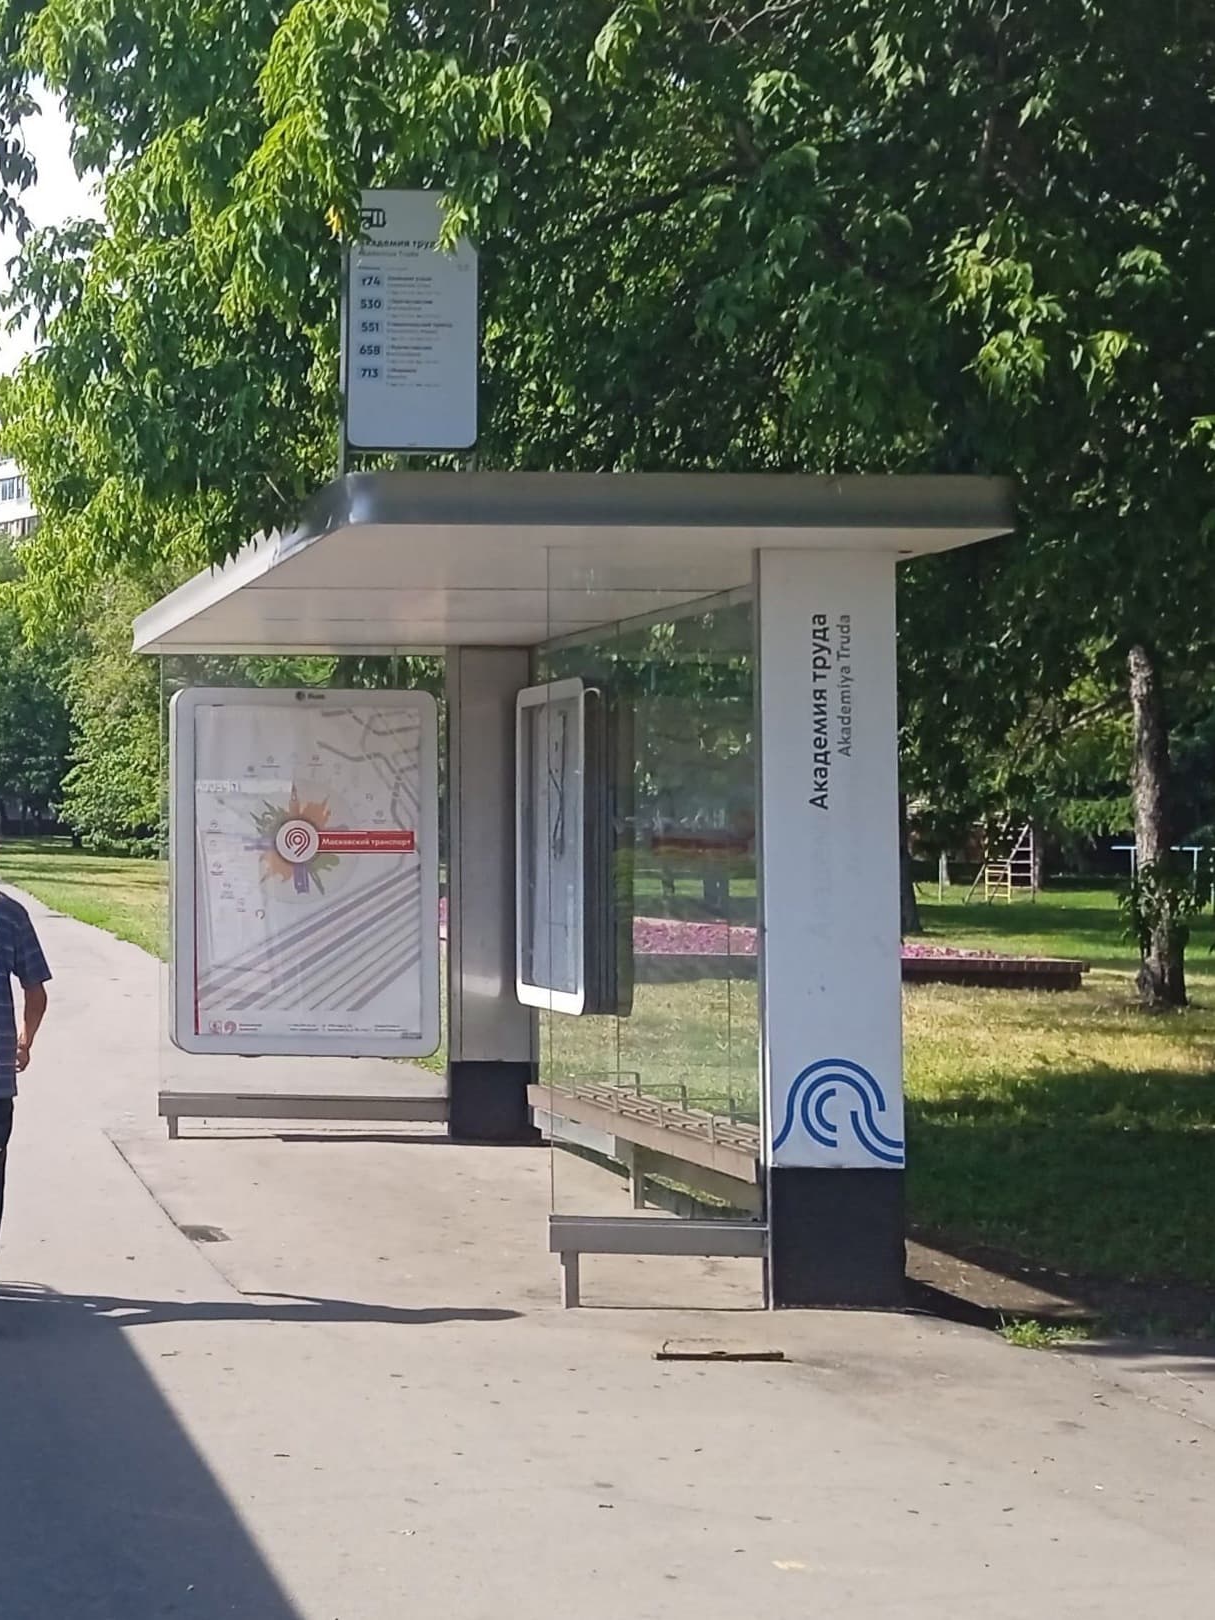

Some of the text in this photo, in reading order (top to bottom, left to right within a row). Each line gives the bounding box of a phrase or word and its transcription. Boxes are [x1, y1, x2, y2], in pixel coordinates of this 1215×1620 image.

[360, 299, 381, 309] 530
[361, 322, 380, 333] 551
[359, 345, 381, 356] 658
[361, 368, 379, 378] 713
[812, 613, 831, 682] труда
[836, 614, 854, 757] Akademiya Truda
[809, 688, 831, 810] Академия
[321, 837, 411, 847] Московский транспорт
